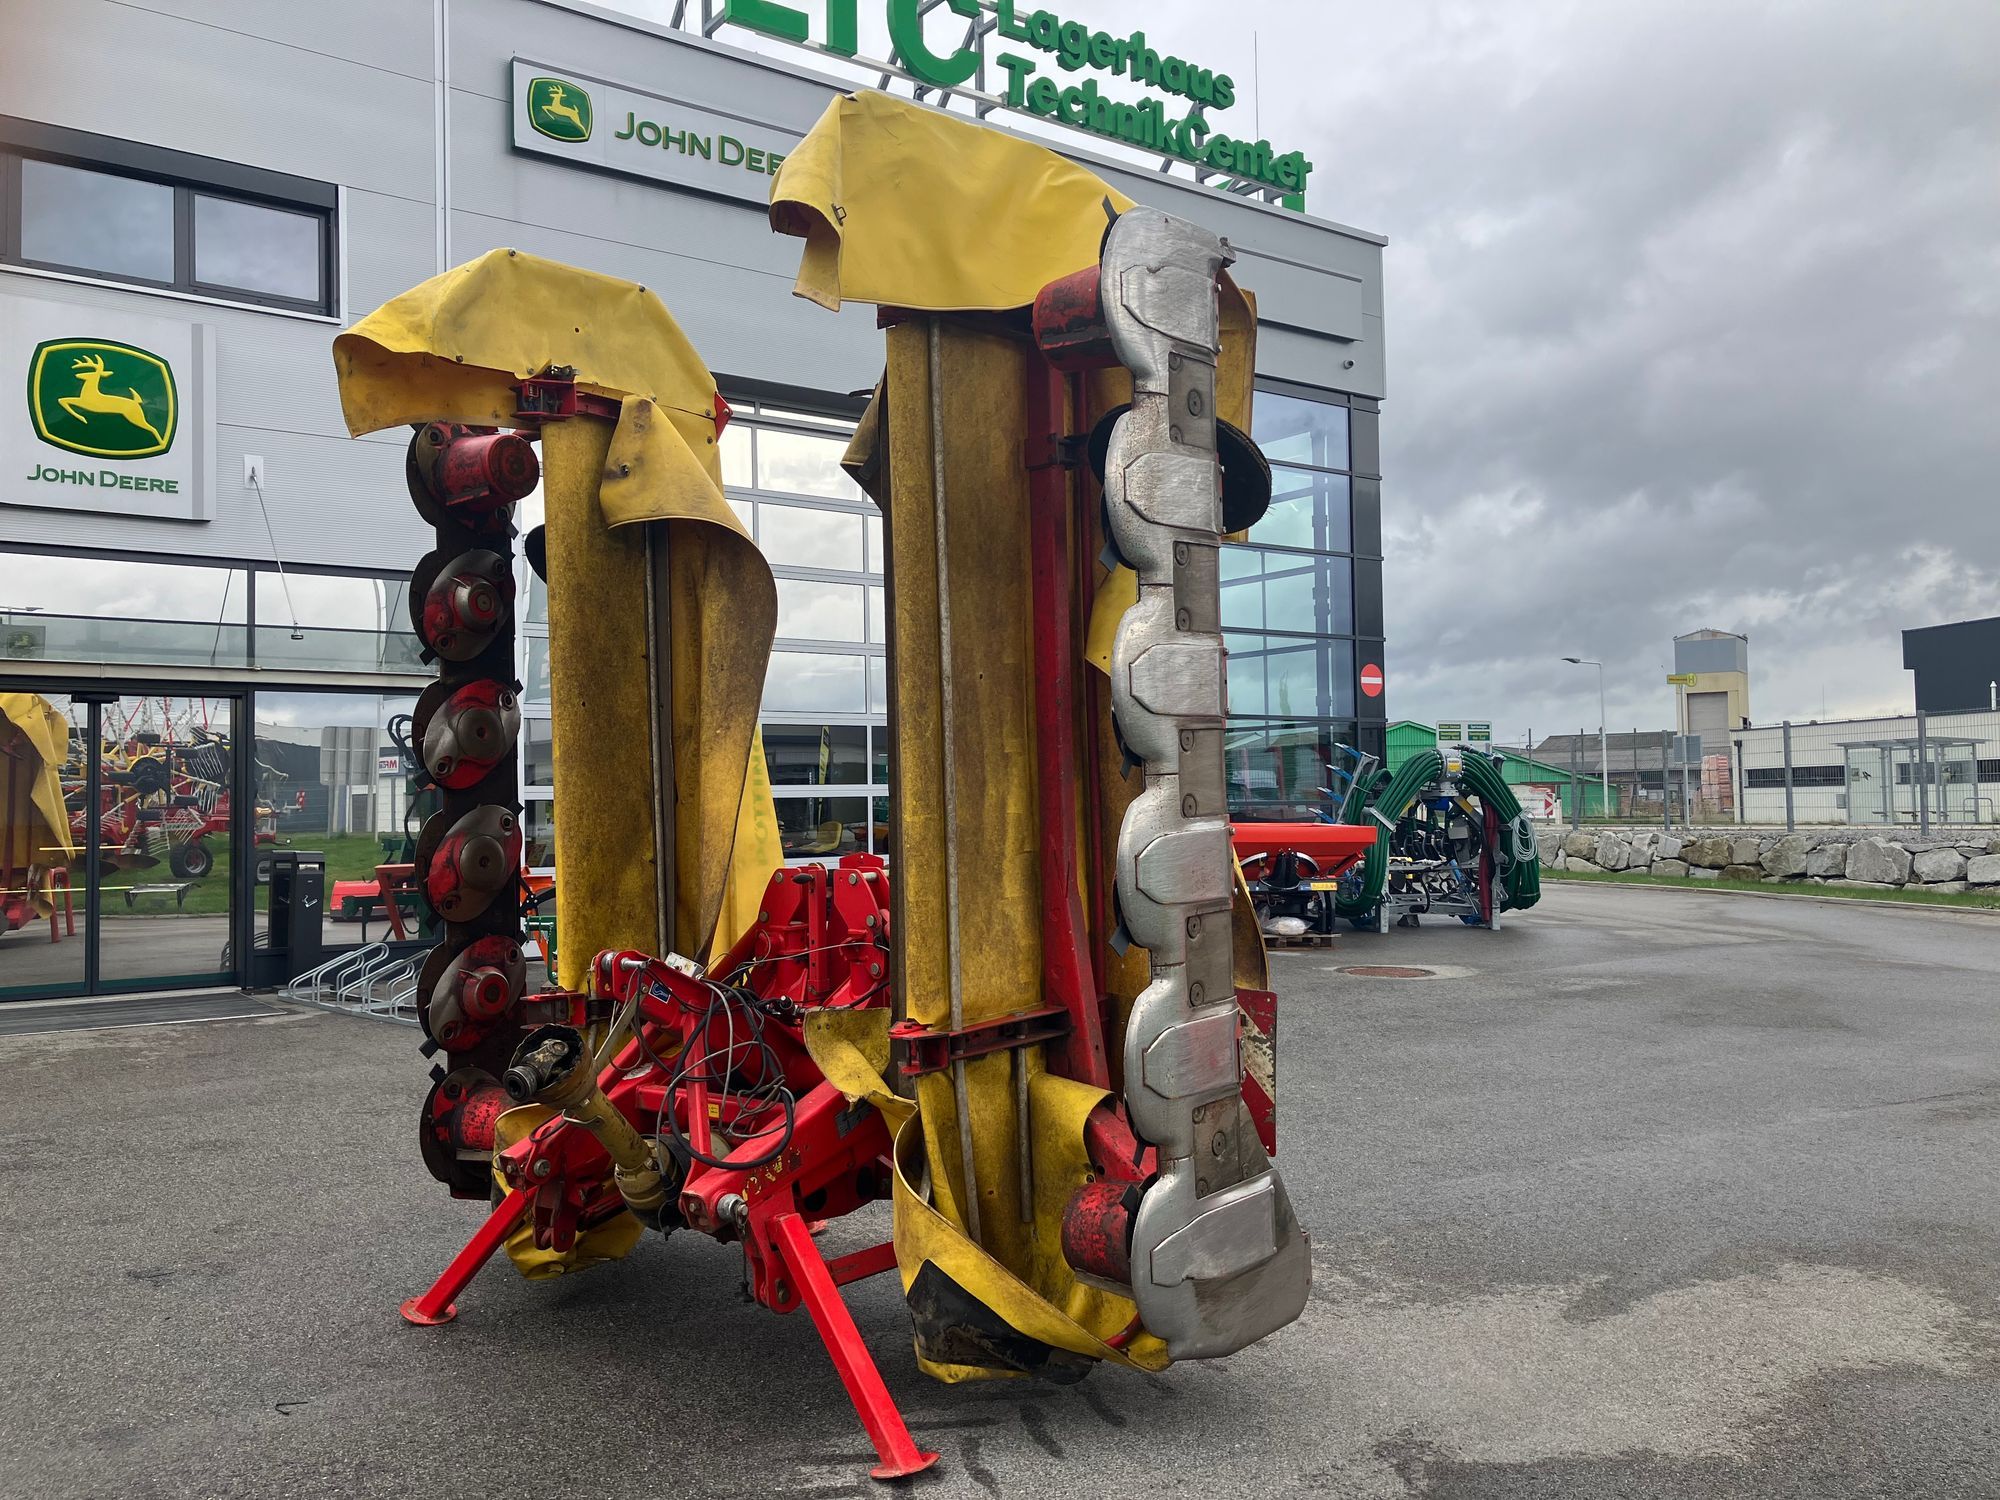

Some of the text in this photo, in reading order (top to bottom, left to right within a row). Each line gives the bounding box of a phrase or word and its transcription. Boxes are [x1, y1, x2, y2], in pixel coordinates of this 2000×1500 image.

[997, 0, 1235, 109] Lagerhaus
[614, 112, 786, 176] JOHN DEE
[996, 52, 1313, 193] TechnikCenter
[27, 464, 179, 494] JOHN DEERE
